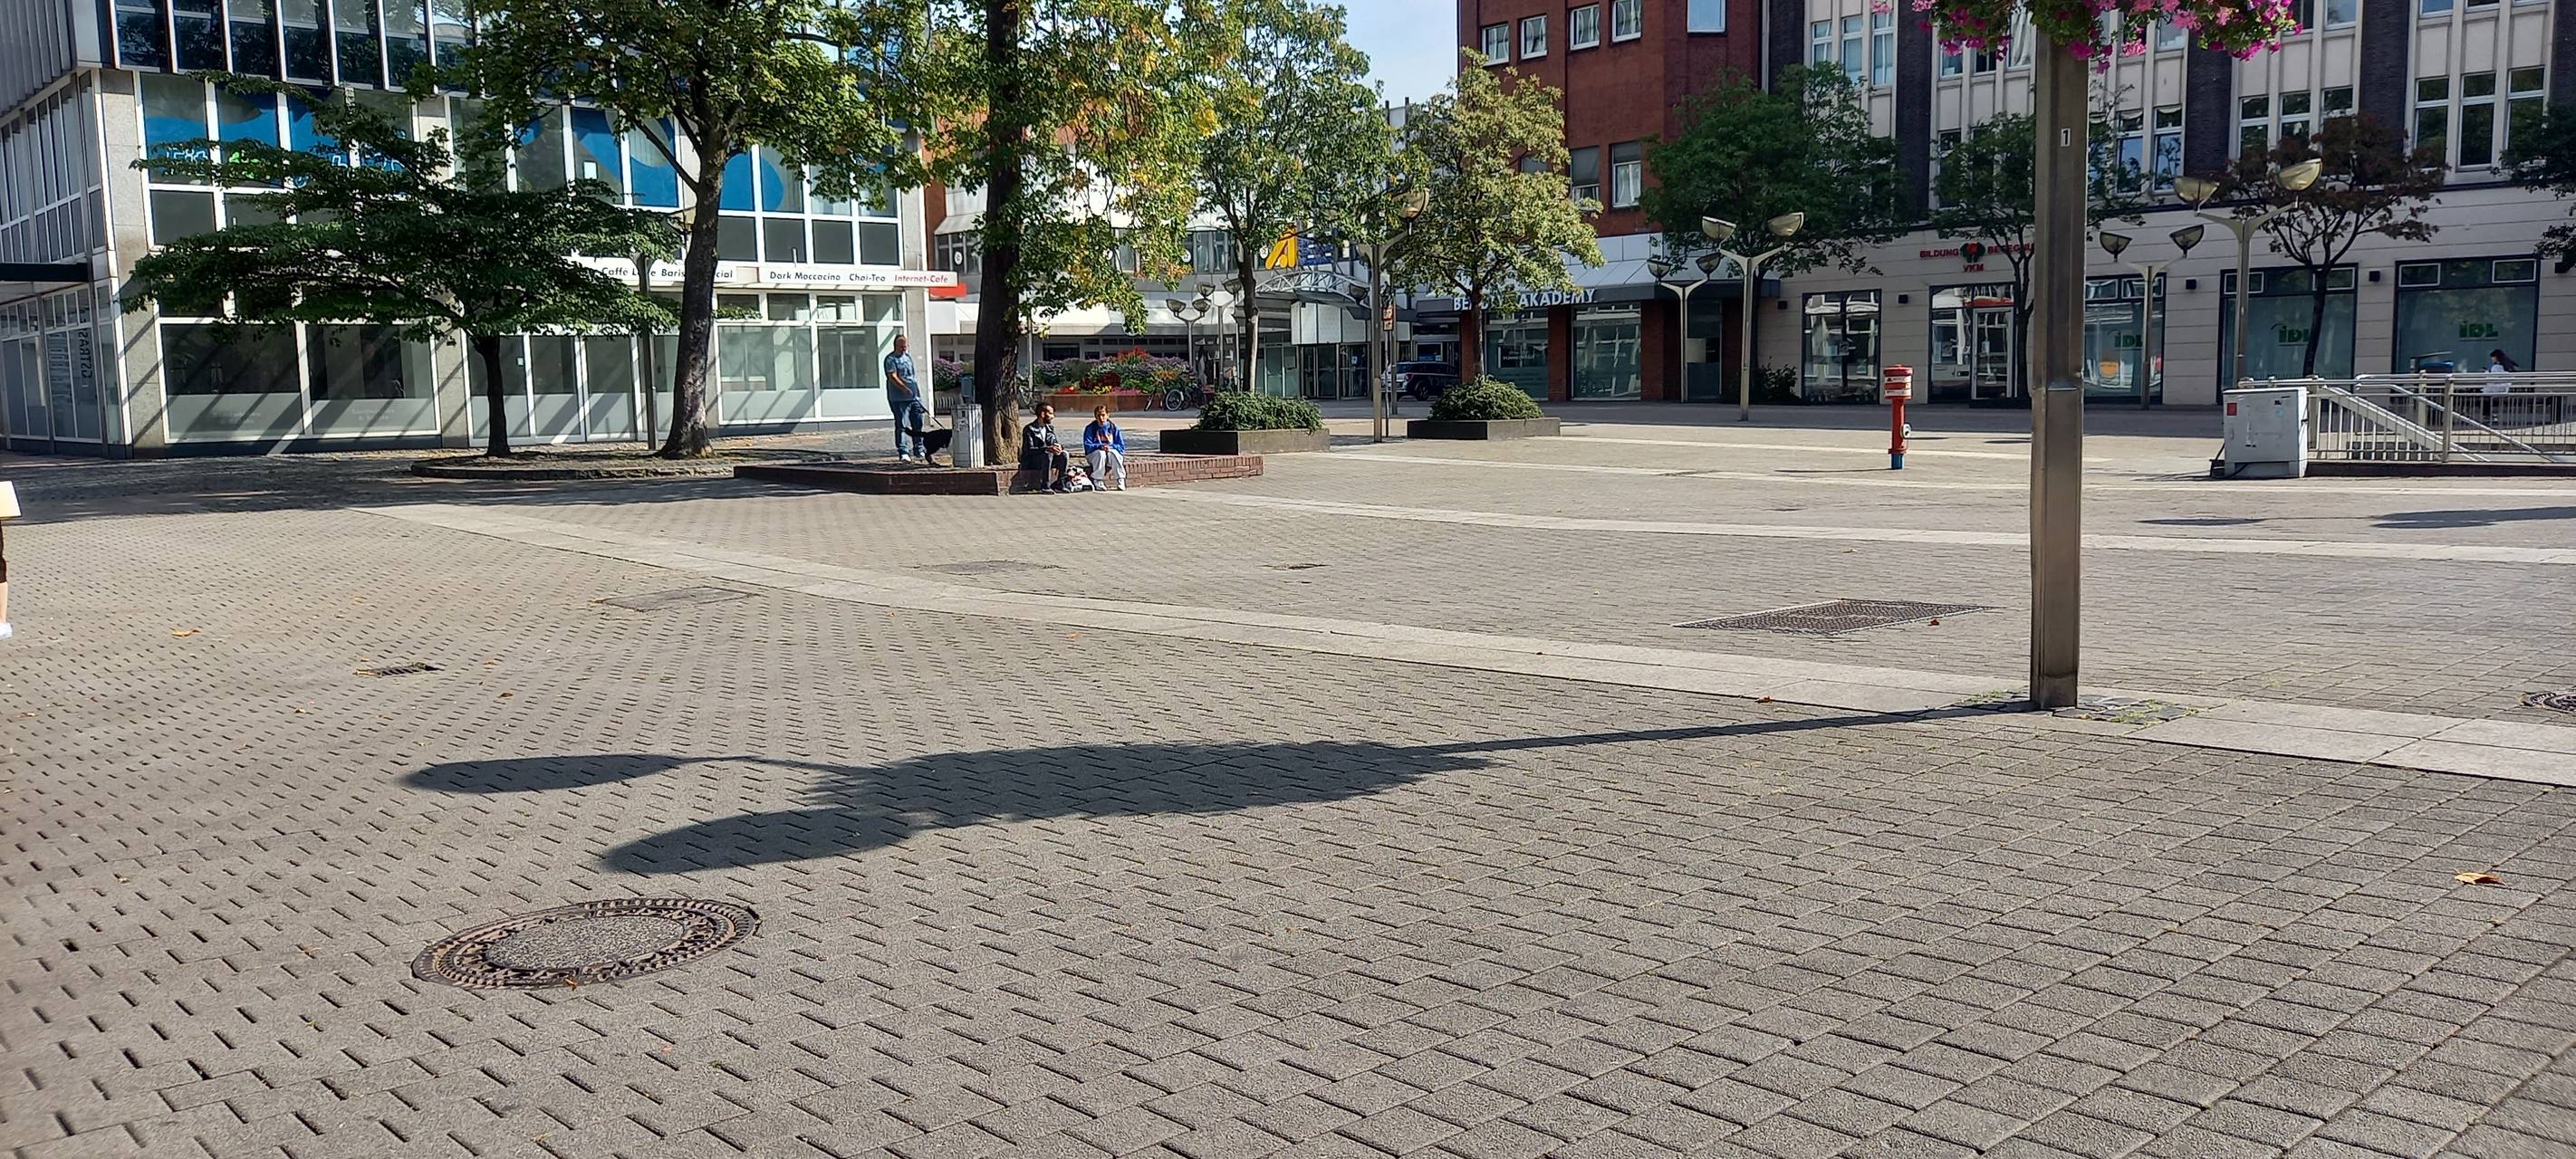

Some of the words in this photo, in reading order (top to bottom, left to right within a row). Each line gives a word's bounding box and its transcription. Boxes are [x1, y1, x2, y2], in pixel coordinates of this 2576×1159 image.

[2062, 129, 2069, 145] 1
[1919, 248, 1959, 258] BILDUNG
[1963, 263, 1985, 273] VKM
[770, 271, 792, 280] Dark
[794, 272, 841, 281] Moccacino
[849, 273, 886, 282] Chai-Tea
[1519, 288, 1595, 308] AKADEMY
